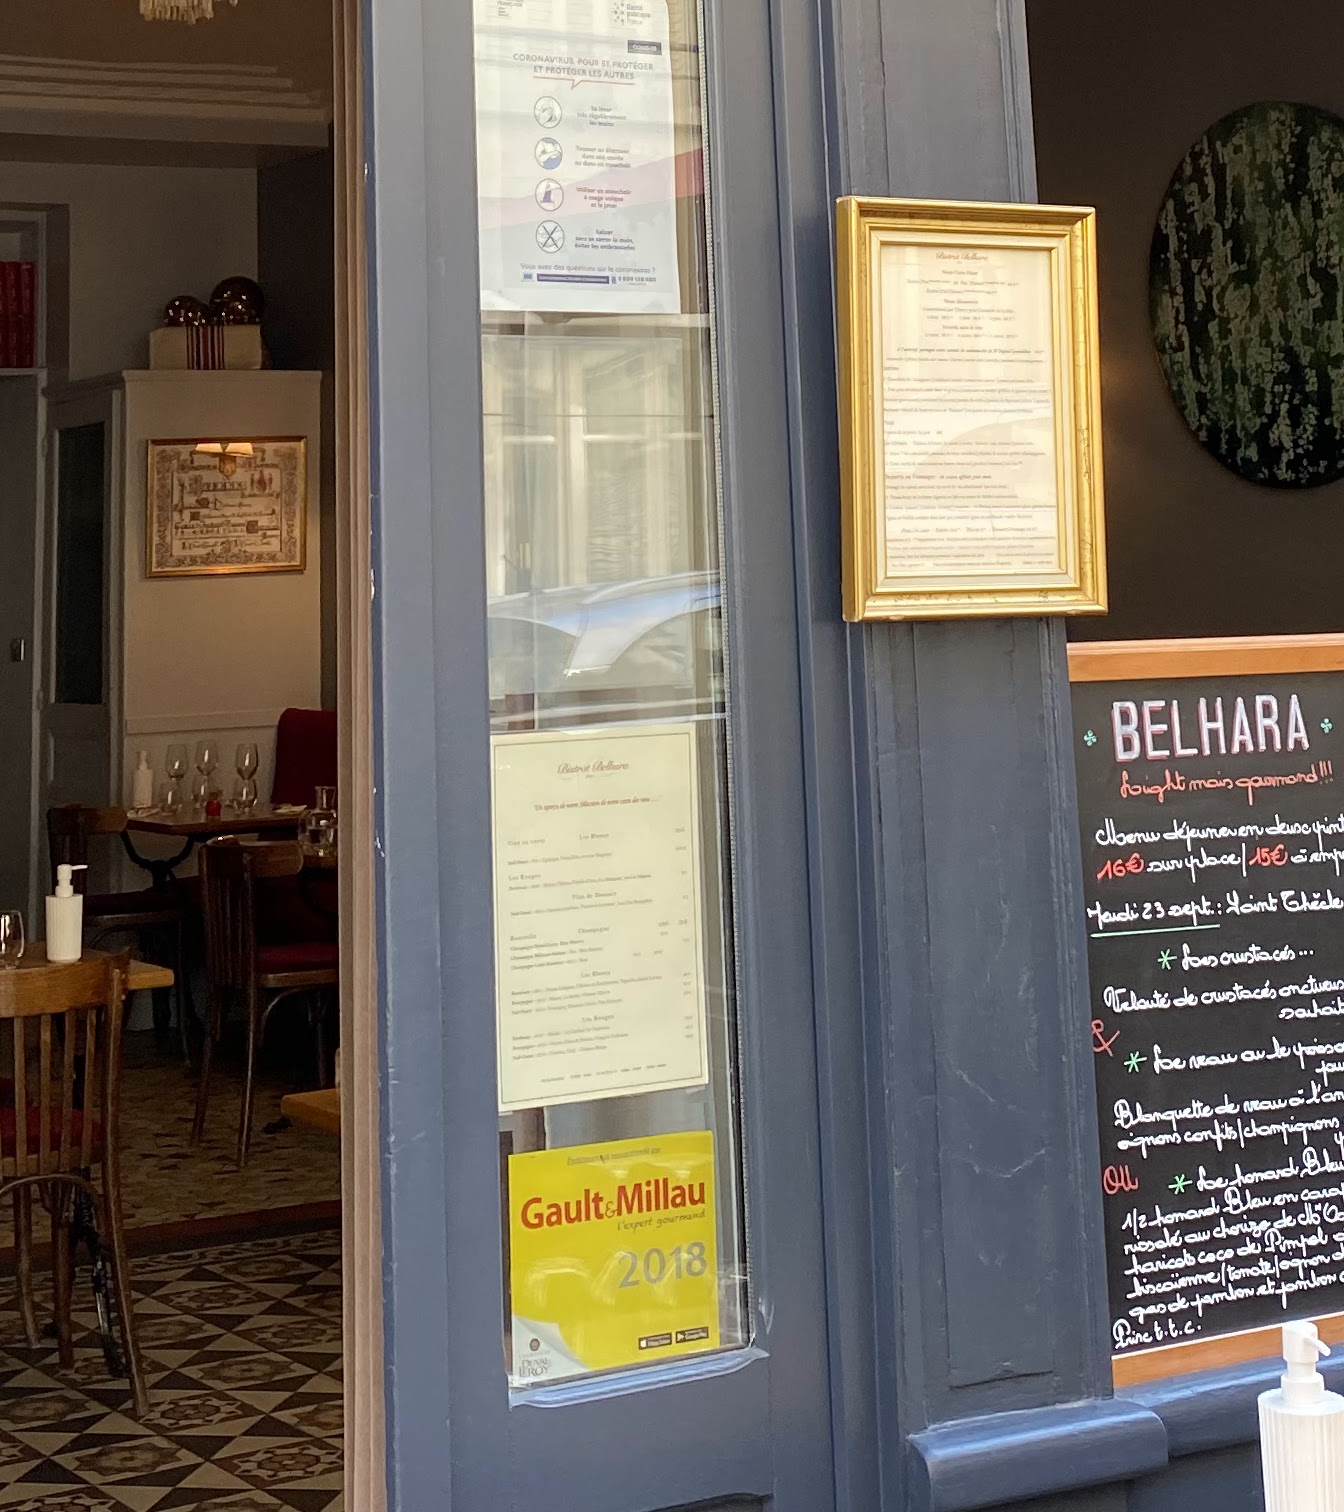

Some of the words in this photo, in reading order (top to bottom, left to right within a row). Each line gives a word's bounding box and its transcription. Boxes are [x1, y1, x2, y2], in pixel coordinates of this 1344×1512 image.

[533, 66, 543, 74] ET
[546, 66, 587, 77] PROTÉGER
[588, 70, 602, 78] LES
[603, 71, 635, 80] AUTRES
[578, 58, 599, 68] POUR
[612, 60, 654, 71] PROTÉGER
[1111, 694, 1310, 762] BELHARA
[1188, 771, 1233, 791] mais
[1096, 818, 1160, 846] Menu
[1163, 819, 1238, 852] déjeuner
[1238, 825, 1264, 838] en
[1097, 852, 1145, 880] 16€
[1146, 859, 1183, 874] sur
[1248, 844, 1289, 867] 15€
[1290, 849, 1308, 864] à
[1087, 901, 1139, 931] Jeudi
[1142, 901, 1165, 921] 23
[1226, 890, 1278, 915] Saint
[1181, 944, 1219, 970] Les
[1103, 985, 1171, 1013] Velouté
[1172, 987, 1198, 1007] de
[1199, 979, 1277, 1004] crustacés
[1153, 1043, 1187, 1074] Le
[1188, 1051, 1238, 1070] veau
[1113, 1097, 1214, 1132] Blanquette
[1214, 1093, 1240, 1115] de
[1243, 1097, 1288, 1113] veau
[1288, 1089, 1306, 1106] à
[1117, 1125, 1182, 1159] oignons
[1196, 1166, 1229, 1192] Le
[1229, 1157, 1299, 1187] homard
[617, 1217, 654, 1236] l'expert
[656, 1209, 707, 1230] gourmand
[1148, 1197, 1220, 1228] homard
[1222, 1186, 1272, 1215] Bleu
[1272, 1193, 1299, 1206] en
[1184, 1230, 1212, 1244] au
[1212, 1216, 1272, 1238] chorizo
[1272, 1209, 1297, 1229] de
[618, 1241, 708, 1289] 2018
[1124, 1248, 1196, 1276] haricots
[1197, 1248, 1235, 1264] coco
[1236, 1237, 1262, 1257] de
[1167, 1292, 1190, 1313] de
[1190, 1283, 1255, 1318] jambon
[1255, 1276, 1276, 1296] et
[1275, 1269, 1337, 1309] jambon
[1113, 1318, 1153, 1349] Prix
